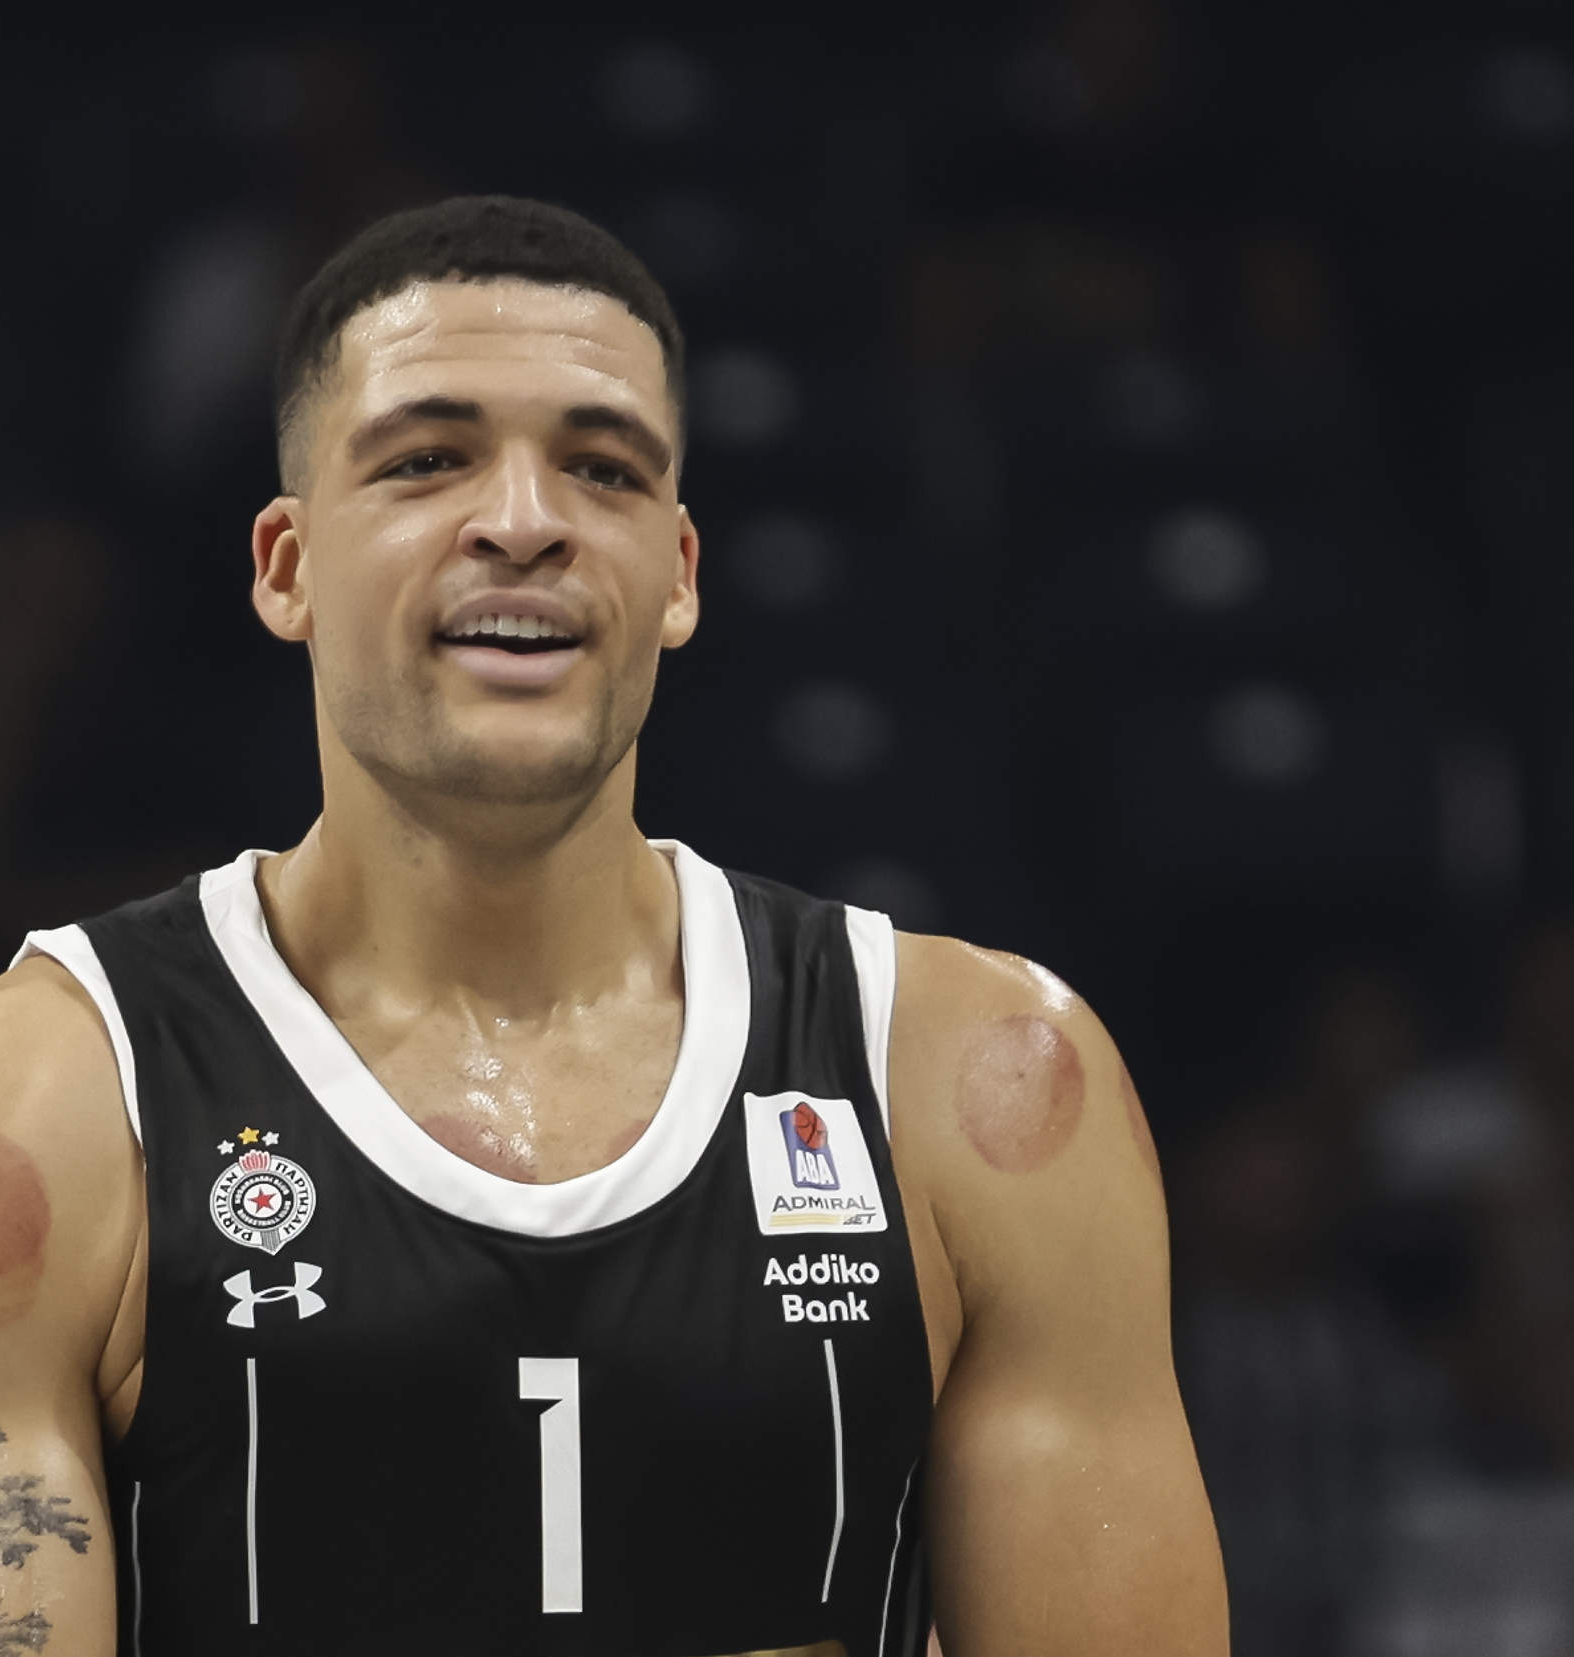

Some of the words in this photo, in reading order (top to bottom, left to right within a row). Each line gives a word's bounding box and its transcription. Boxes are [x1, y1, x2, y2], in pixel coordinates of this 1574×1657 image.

[796, 1149, 835, 1184] ABA
[216, 1172, 253, 1241] PARTIZAN
[772, 1195, 876, 1212] ADMIRAL
[763, 1253, 880, 1286] Addiko
[781, 1291, 871, 1323] Bank
[518, 1356, 583, 1614] 1
